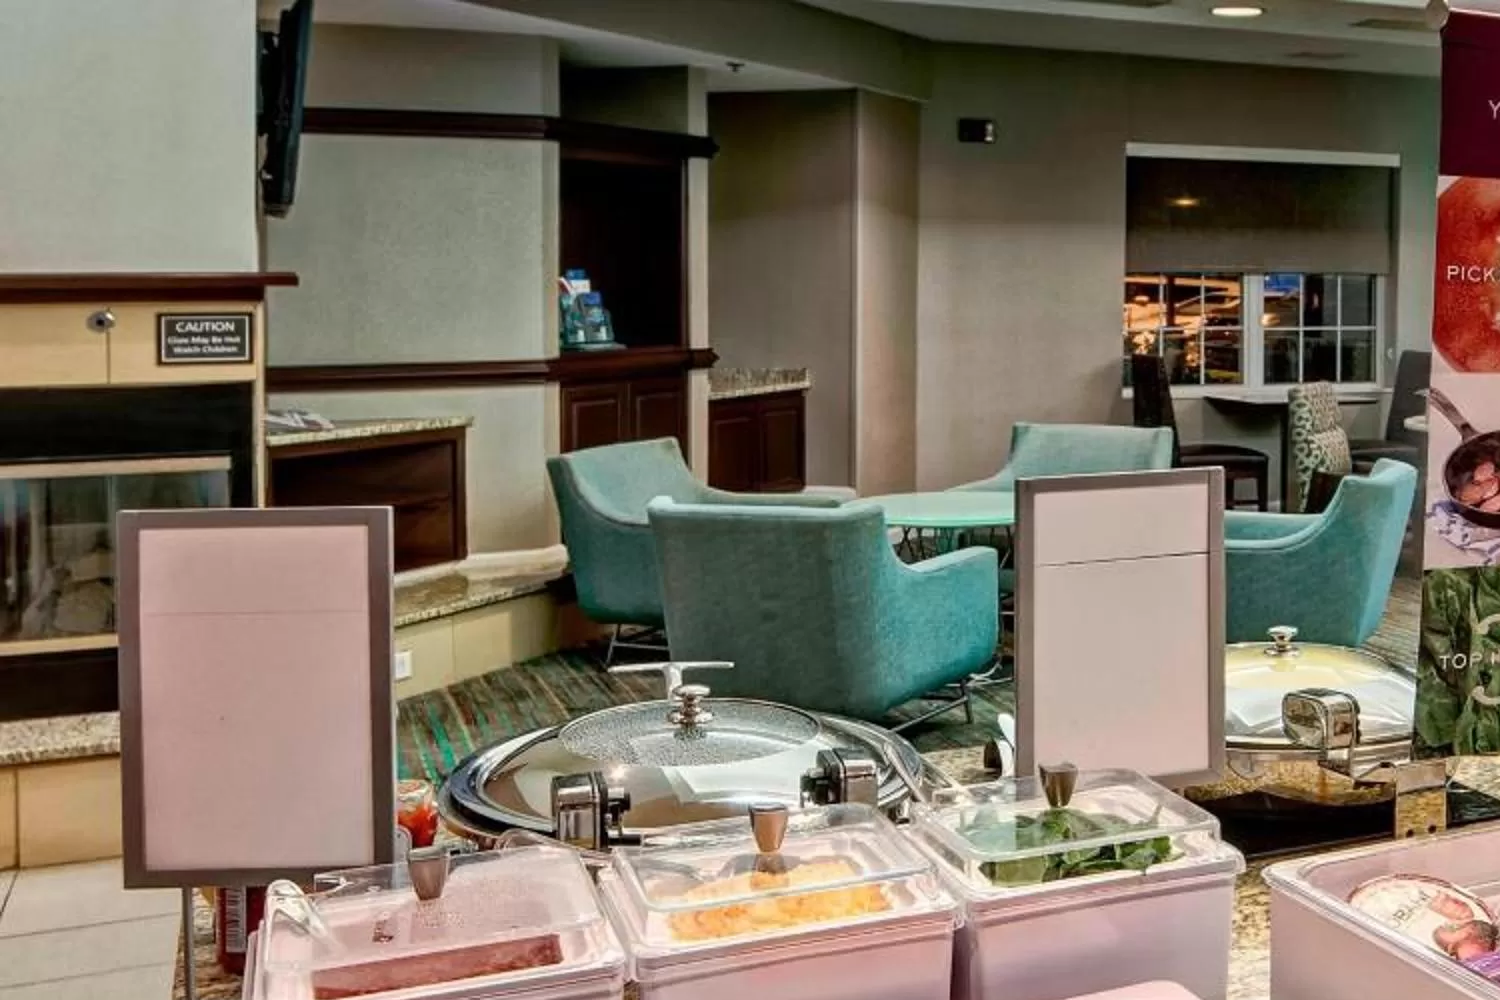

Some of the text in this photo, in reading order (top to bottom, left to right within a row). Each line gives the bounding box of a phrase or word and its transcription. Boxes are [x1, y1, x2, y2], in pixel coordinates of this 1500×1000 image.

[1447, 264, 1495, 283] PICK
[175, 321, 235, 333] CAUTION
[1439, 651, 1483, 671] TOP
